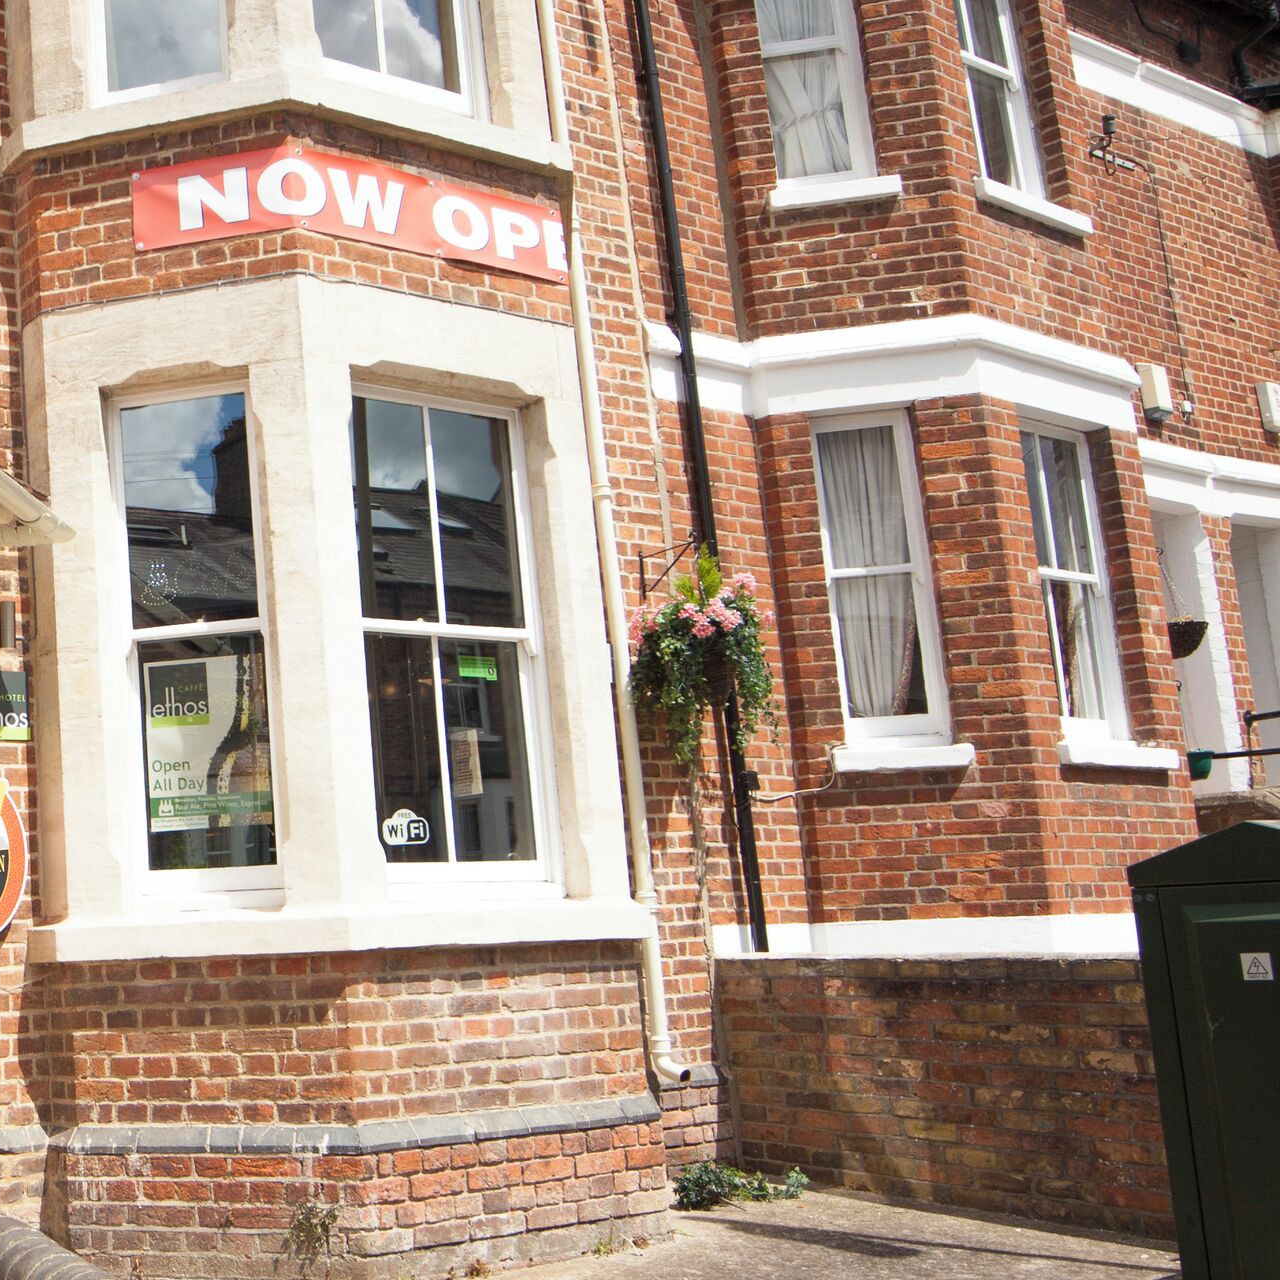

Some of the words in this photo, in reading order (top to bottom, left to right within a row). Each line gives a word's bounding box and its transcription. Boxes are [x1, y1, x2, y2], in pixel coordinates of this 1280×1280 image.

[176, 157, 406, 235] NOW
[152, 686, 208, 718] ethos
[152, 759, 191, 775] Open
[153, 778, 173, 792] All
[177, 777, 205, 793] Day
